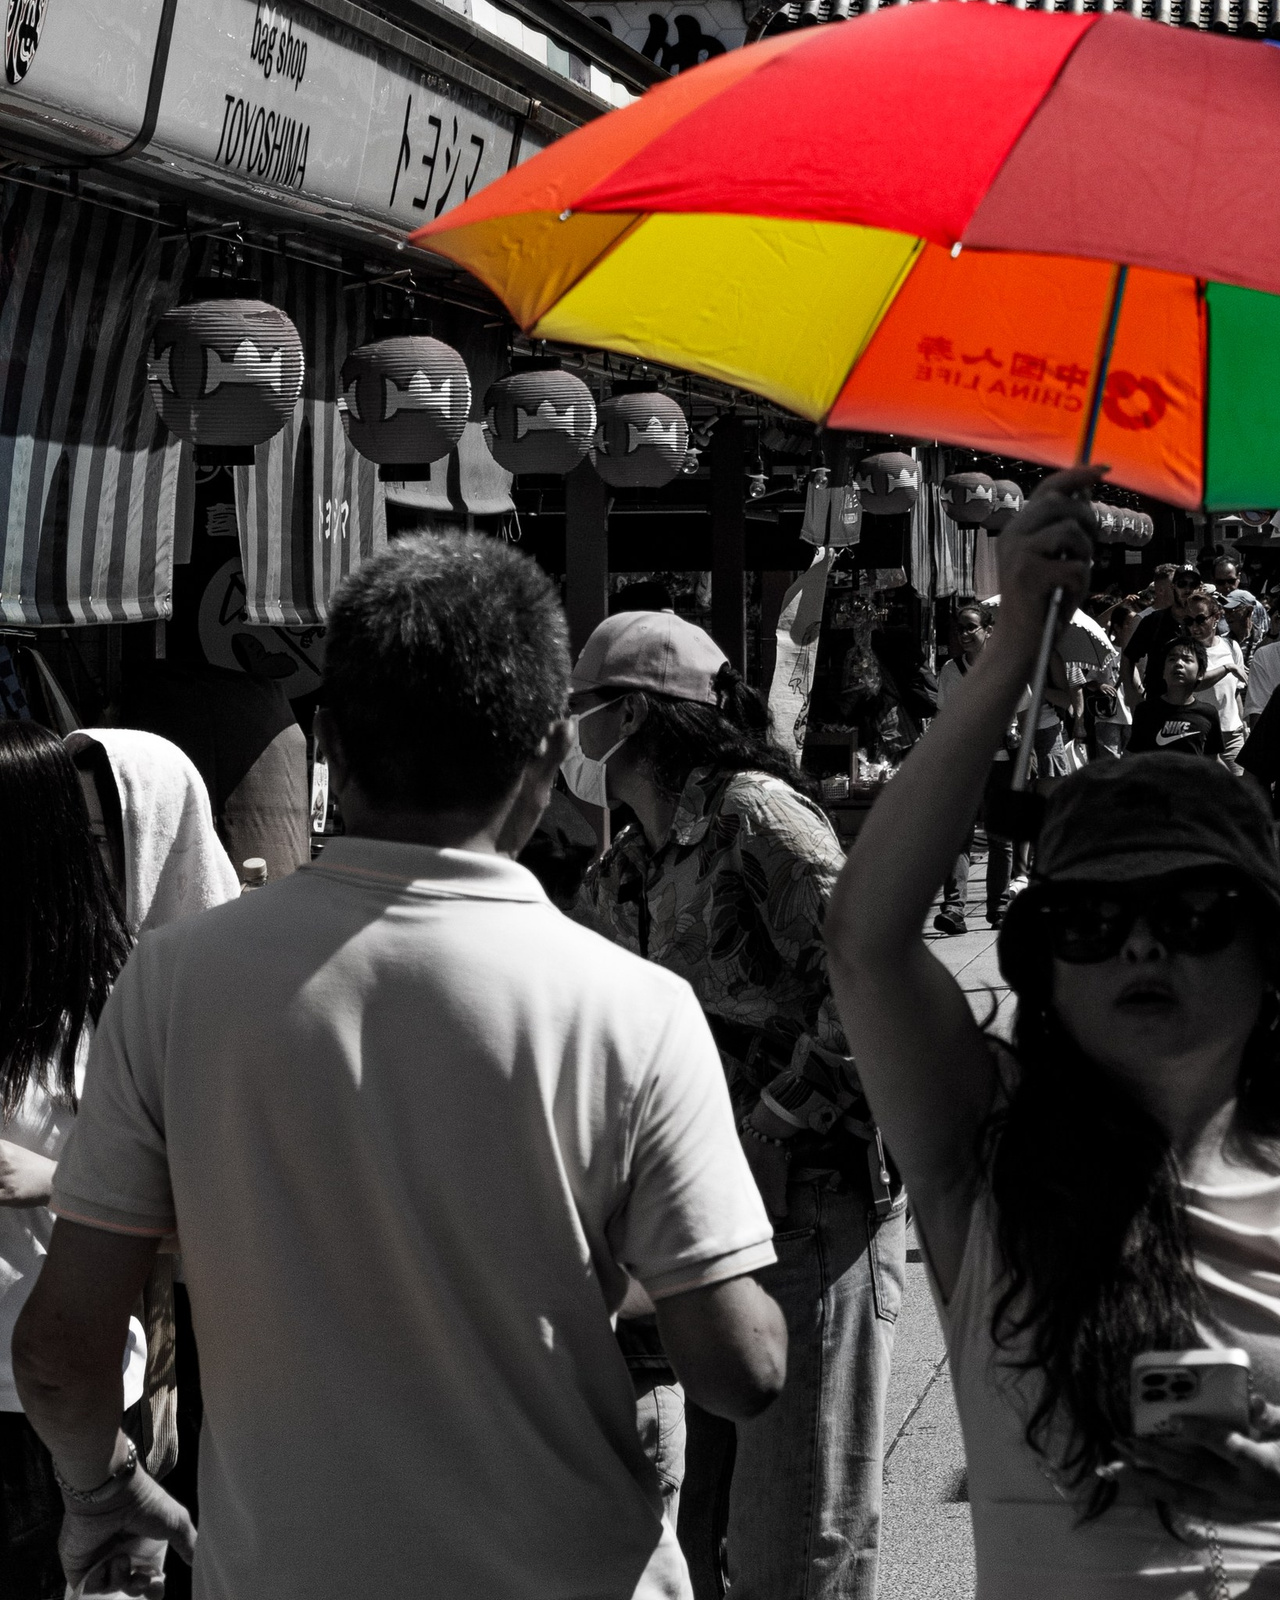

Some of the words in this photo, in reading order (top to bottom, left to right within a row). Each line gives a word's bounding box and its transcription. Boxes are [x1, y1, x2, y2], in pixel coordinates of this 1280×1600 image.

[276, 17, 309, 92] shop
[214, 93, 310, 190] TOYOSHIMA
[318, 493, 350, 545] トヨシマ
[1161, 720, 1192, 736] NIKE
